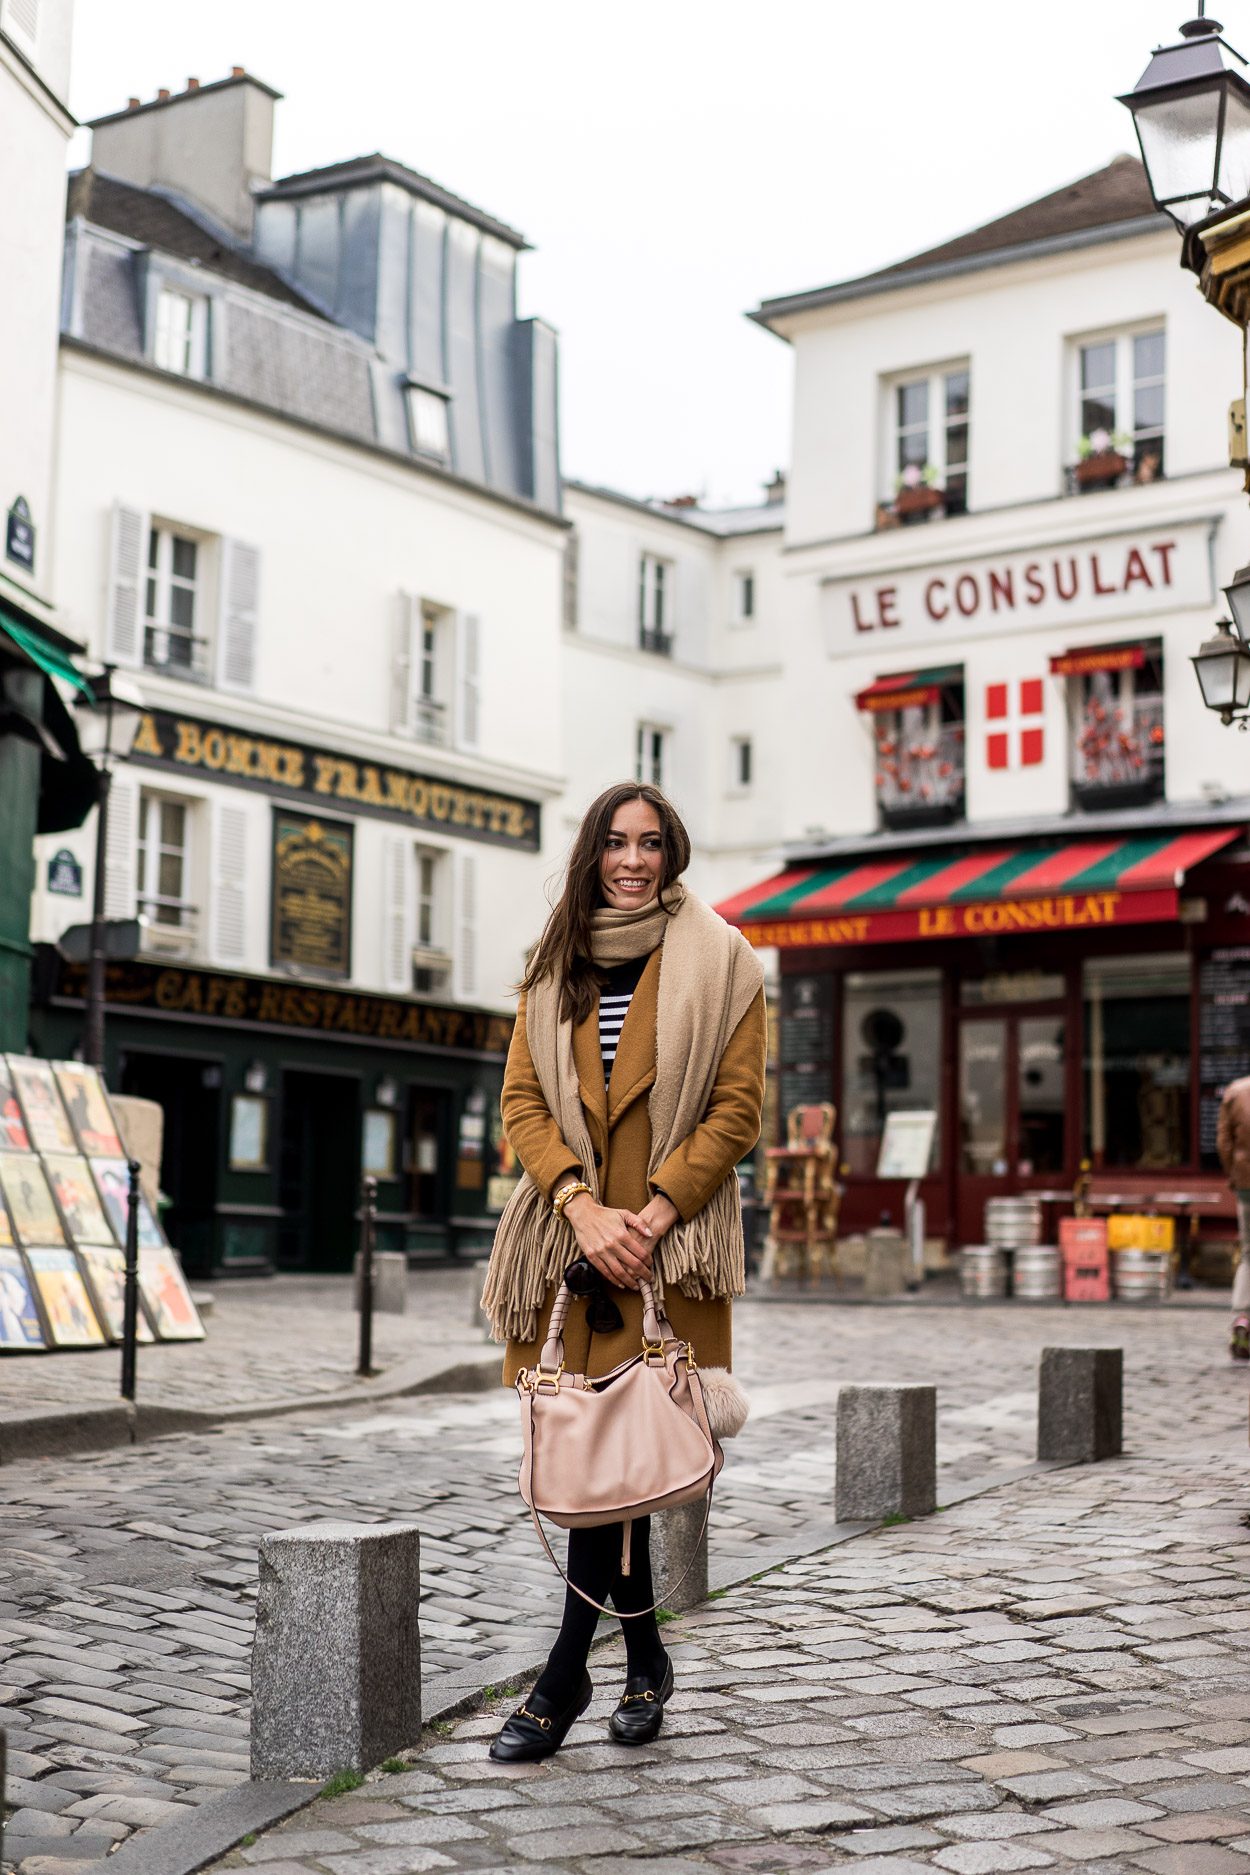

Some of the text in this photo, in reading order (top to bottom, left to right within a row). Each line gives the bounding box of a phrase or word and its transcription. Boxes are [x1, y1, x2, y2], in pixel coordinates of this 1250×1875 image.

[851, 540, 1177, 633] LE CONSULAT
[173, 719, 305, 789] BONNE
[313, 753, 526, 838] FRANQUETTE
[918, 906, 956, 938] LE
[964, 892, 1122, 933] CONSULAT
